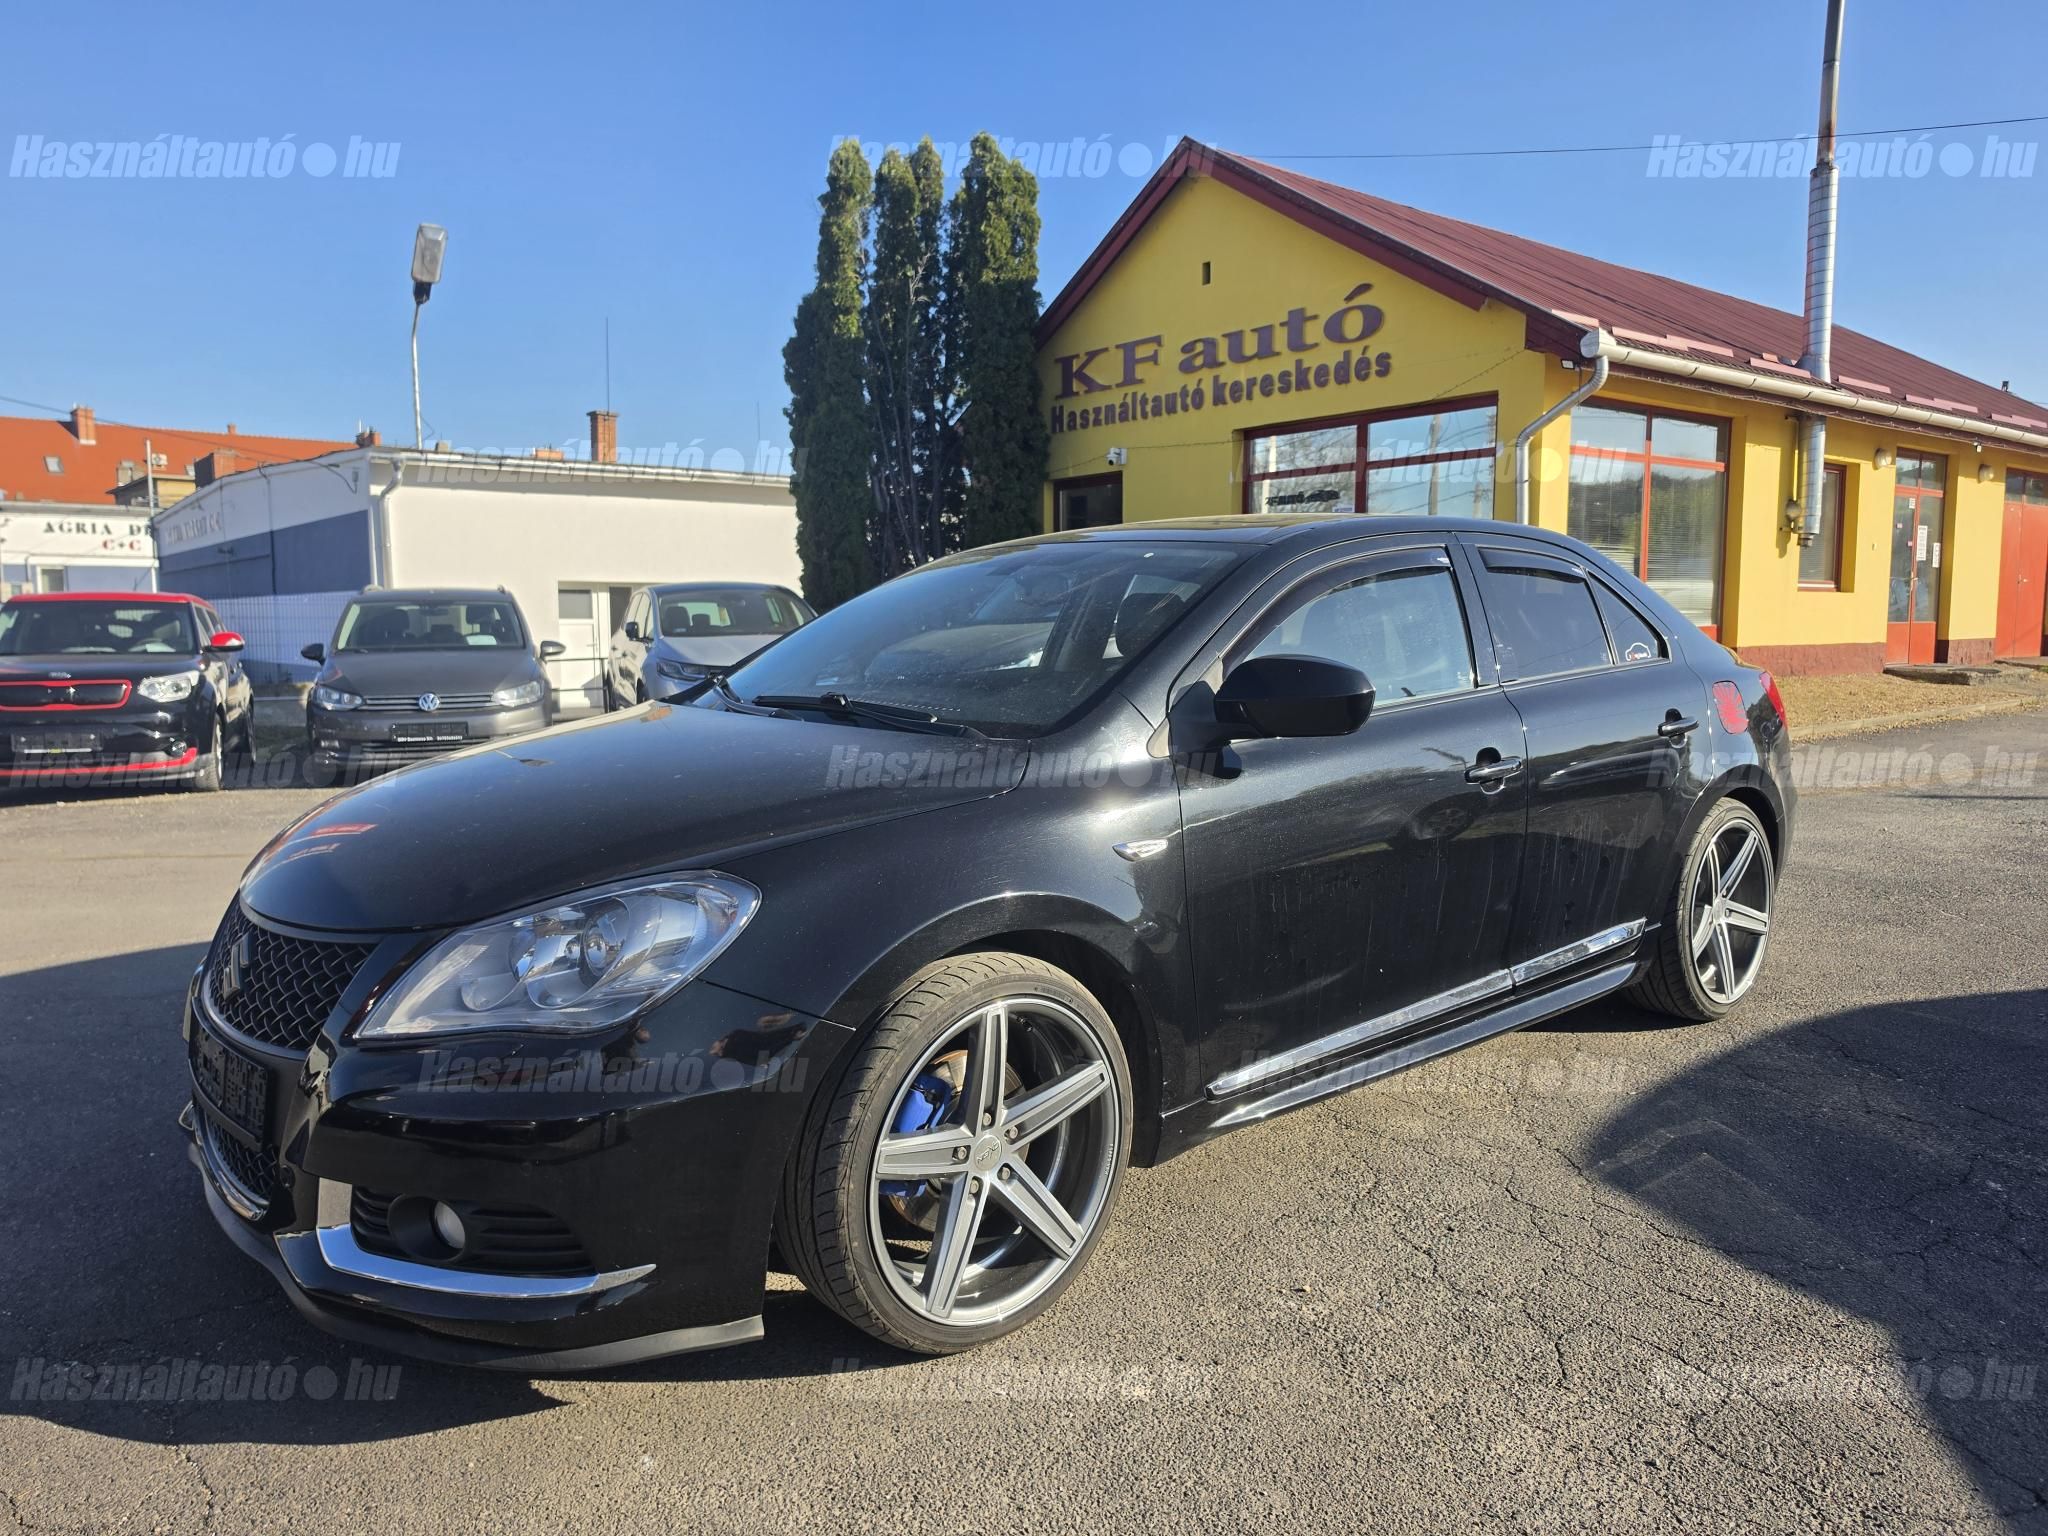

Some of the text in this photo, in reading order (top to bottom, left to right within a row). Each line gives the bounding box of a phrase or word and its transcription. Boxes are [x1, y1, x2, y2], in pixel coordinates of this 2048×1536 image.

[1054, 283, 1384, 399] KF autó
[1050, 345, 1392, 435] Használtautó kereskedés
[43, 522, 113, 536] AGRIA
